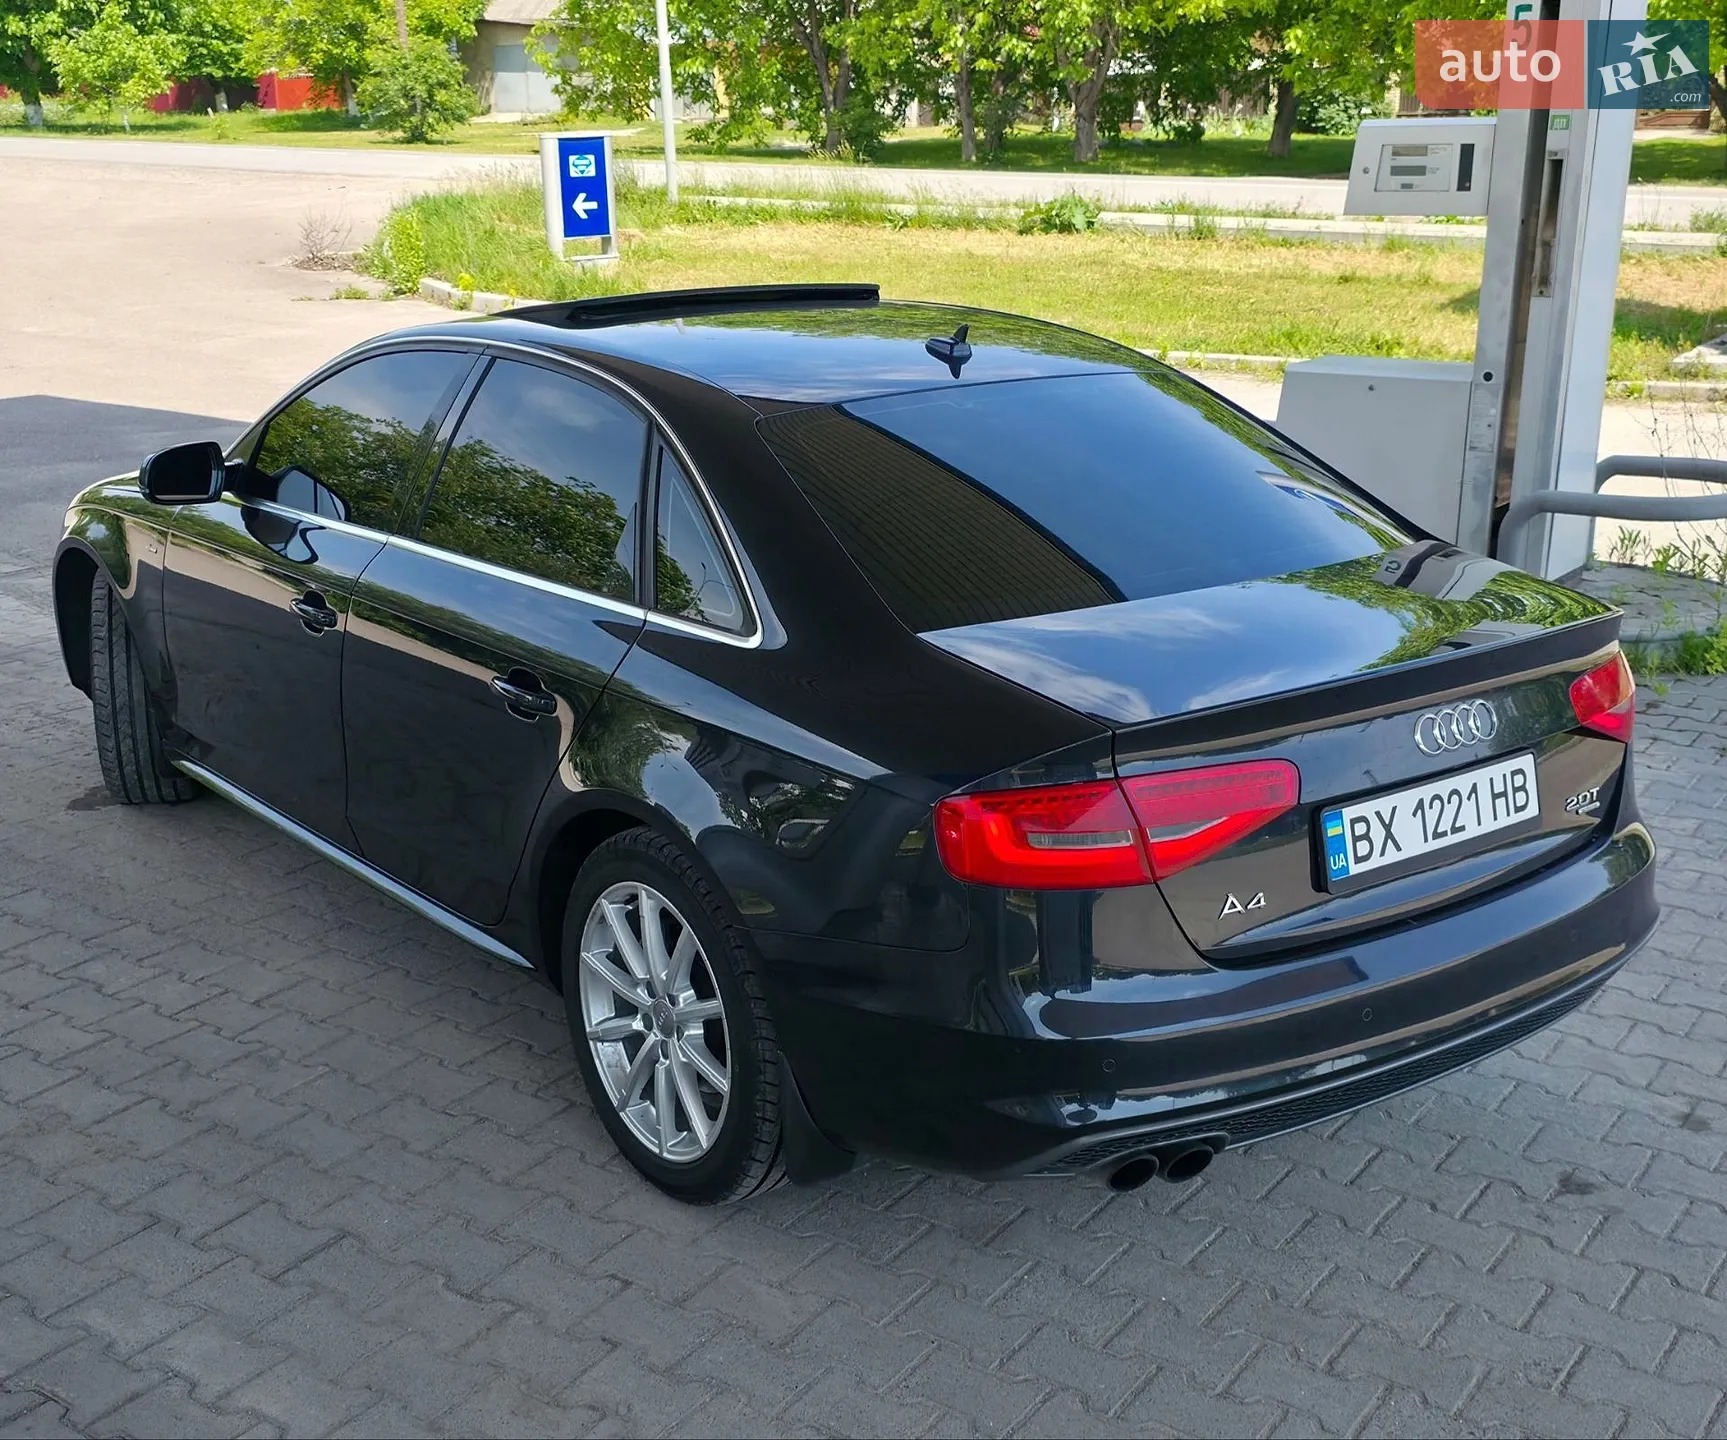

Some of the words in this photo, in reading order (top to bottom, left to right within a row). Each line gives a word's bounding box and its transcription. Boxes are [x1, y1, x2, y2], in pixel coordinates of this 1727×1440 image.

[1511, 4, 1533, 52] 5
[1349, 805, 1402, 865] BX
[1411, 781, 1482, 844] 1221
[1489, 767, 1530, 822] HB
[1330, 852, 1348, 870] UA
[1217, 892, 1267, 921] A4
